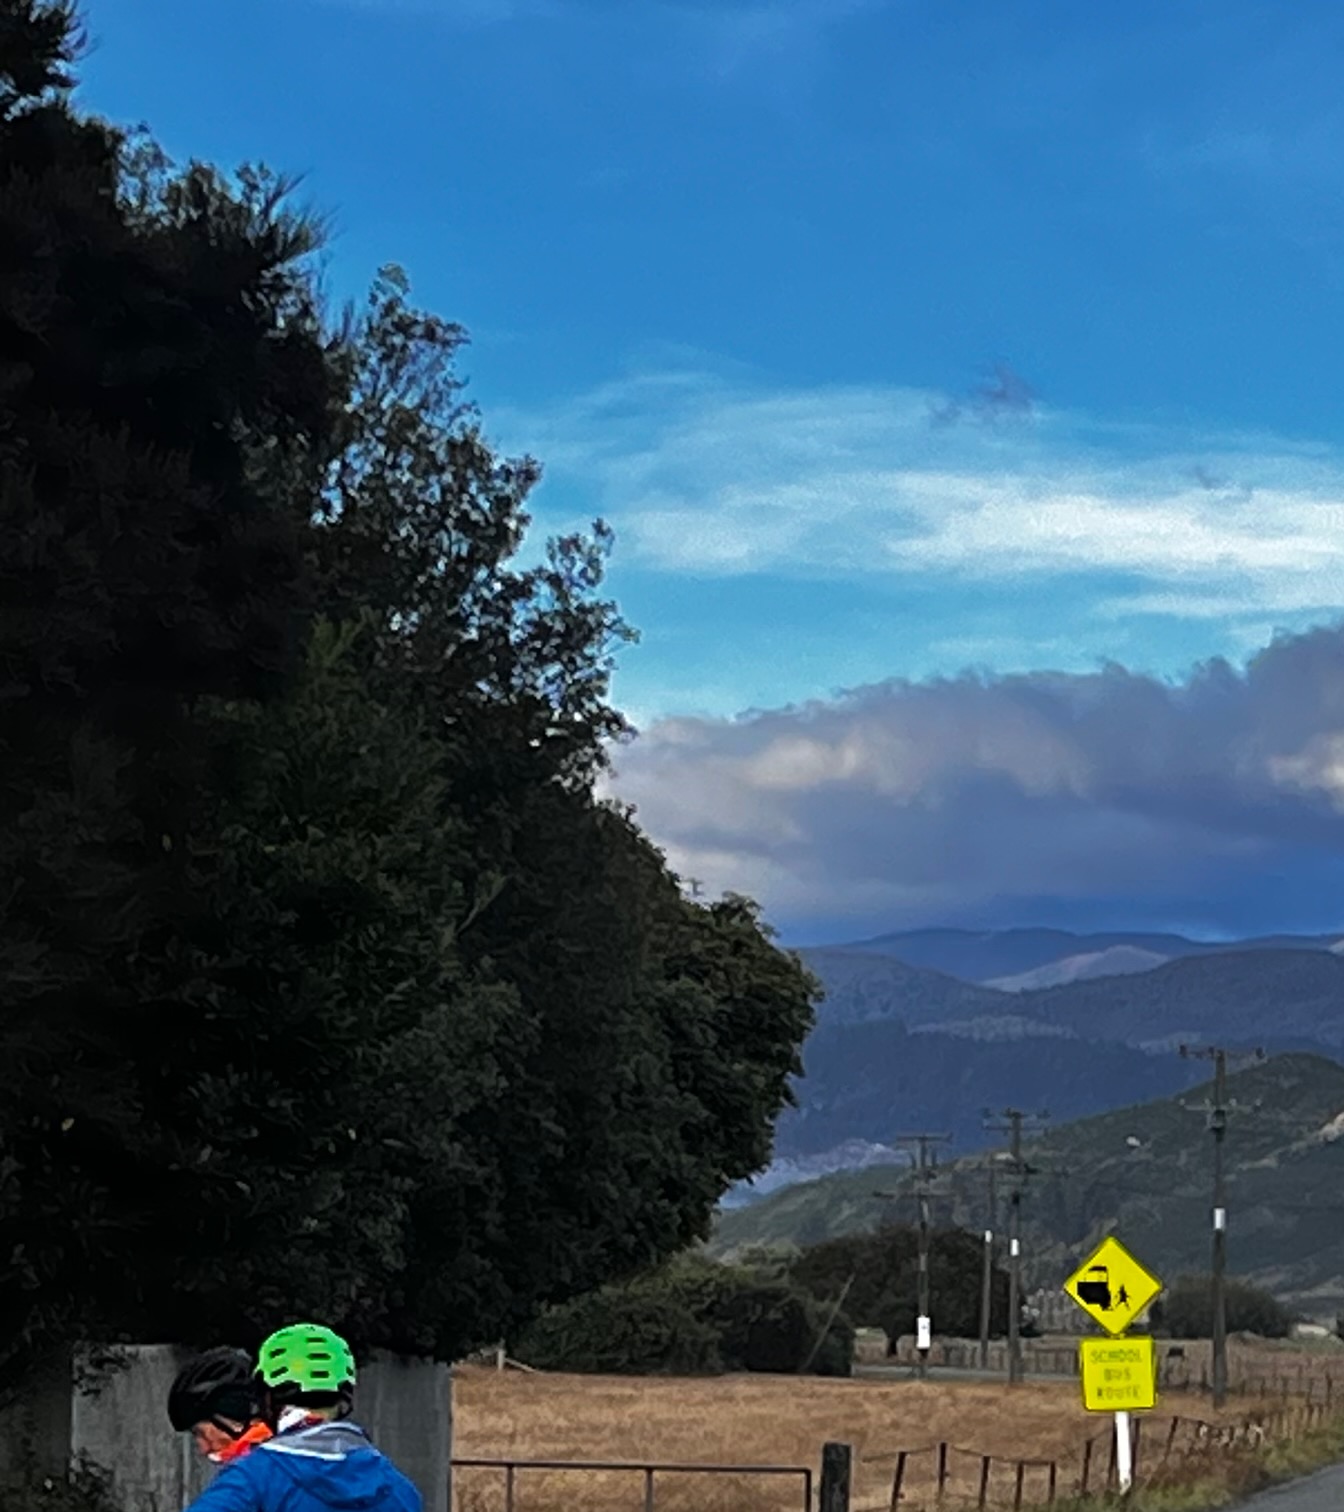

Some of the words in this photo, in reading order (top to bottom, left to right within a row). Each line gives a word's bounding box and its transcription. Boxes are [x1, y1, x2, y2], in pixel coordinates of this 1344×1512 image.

[1090, 1349, 1142, 1364] SCHOOL
[1103, 1367, 1132, 1381] BUS
[1096, 1384, 1141, 1400] ROUTE
